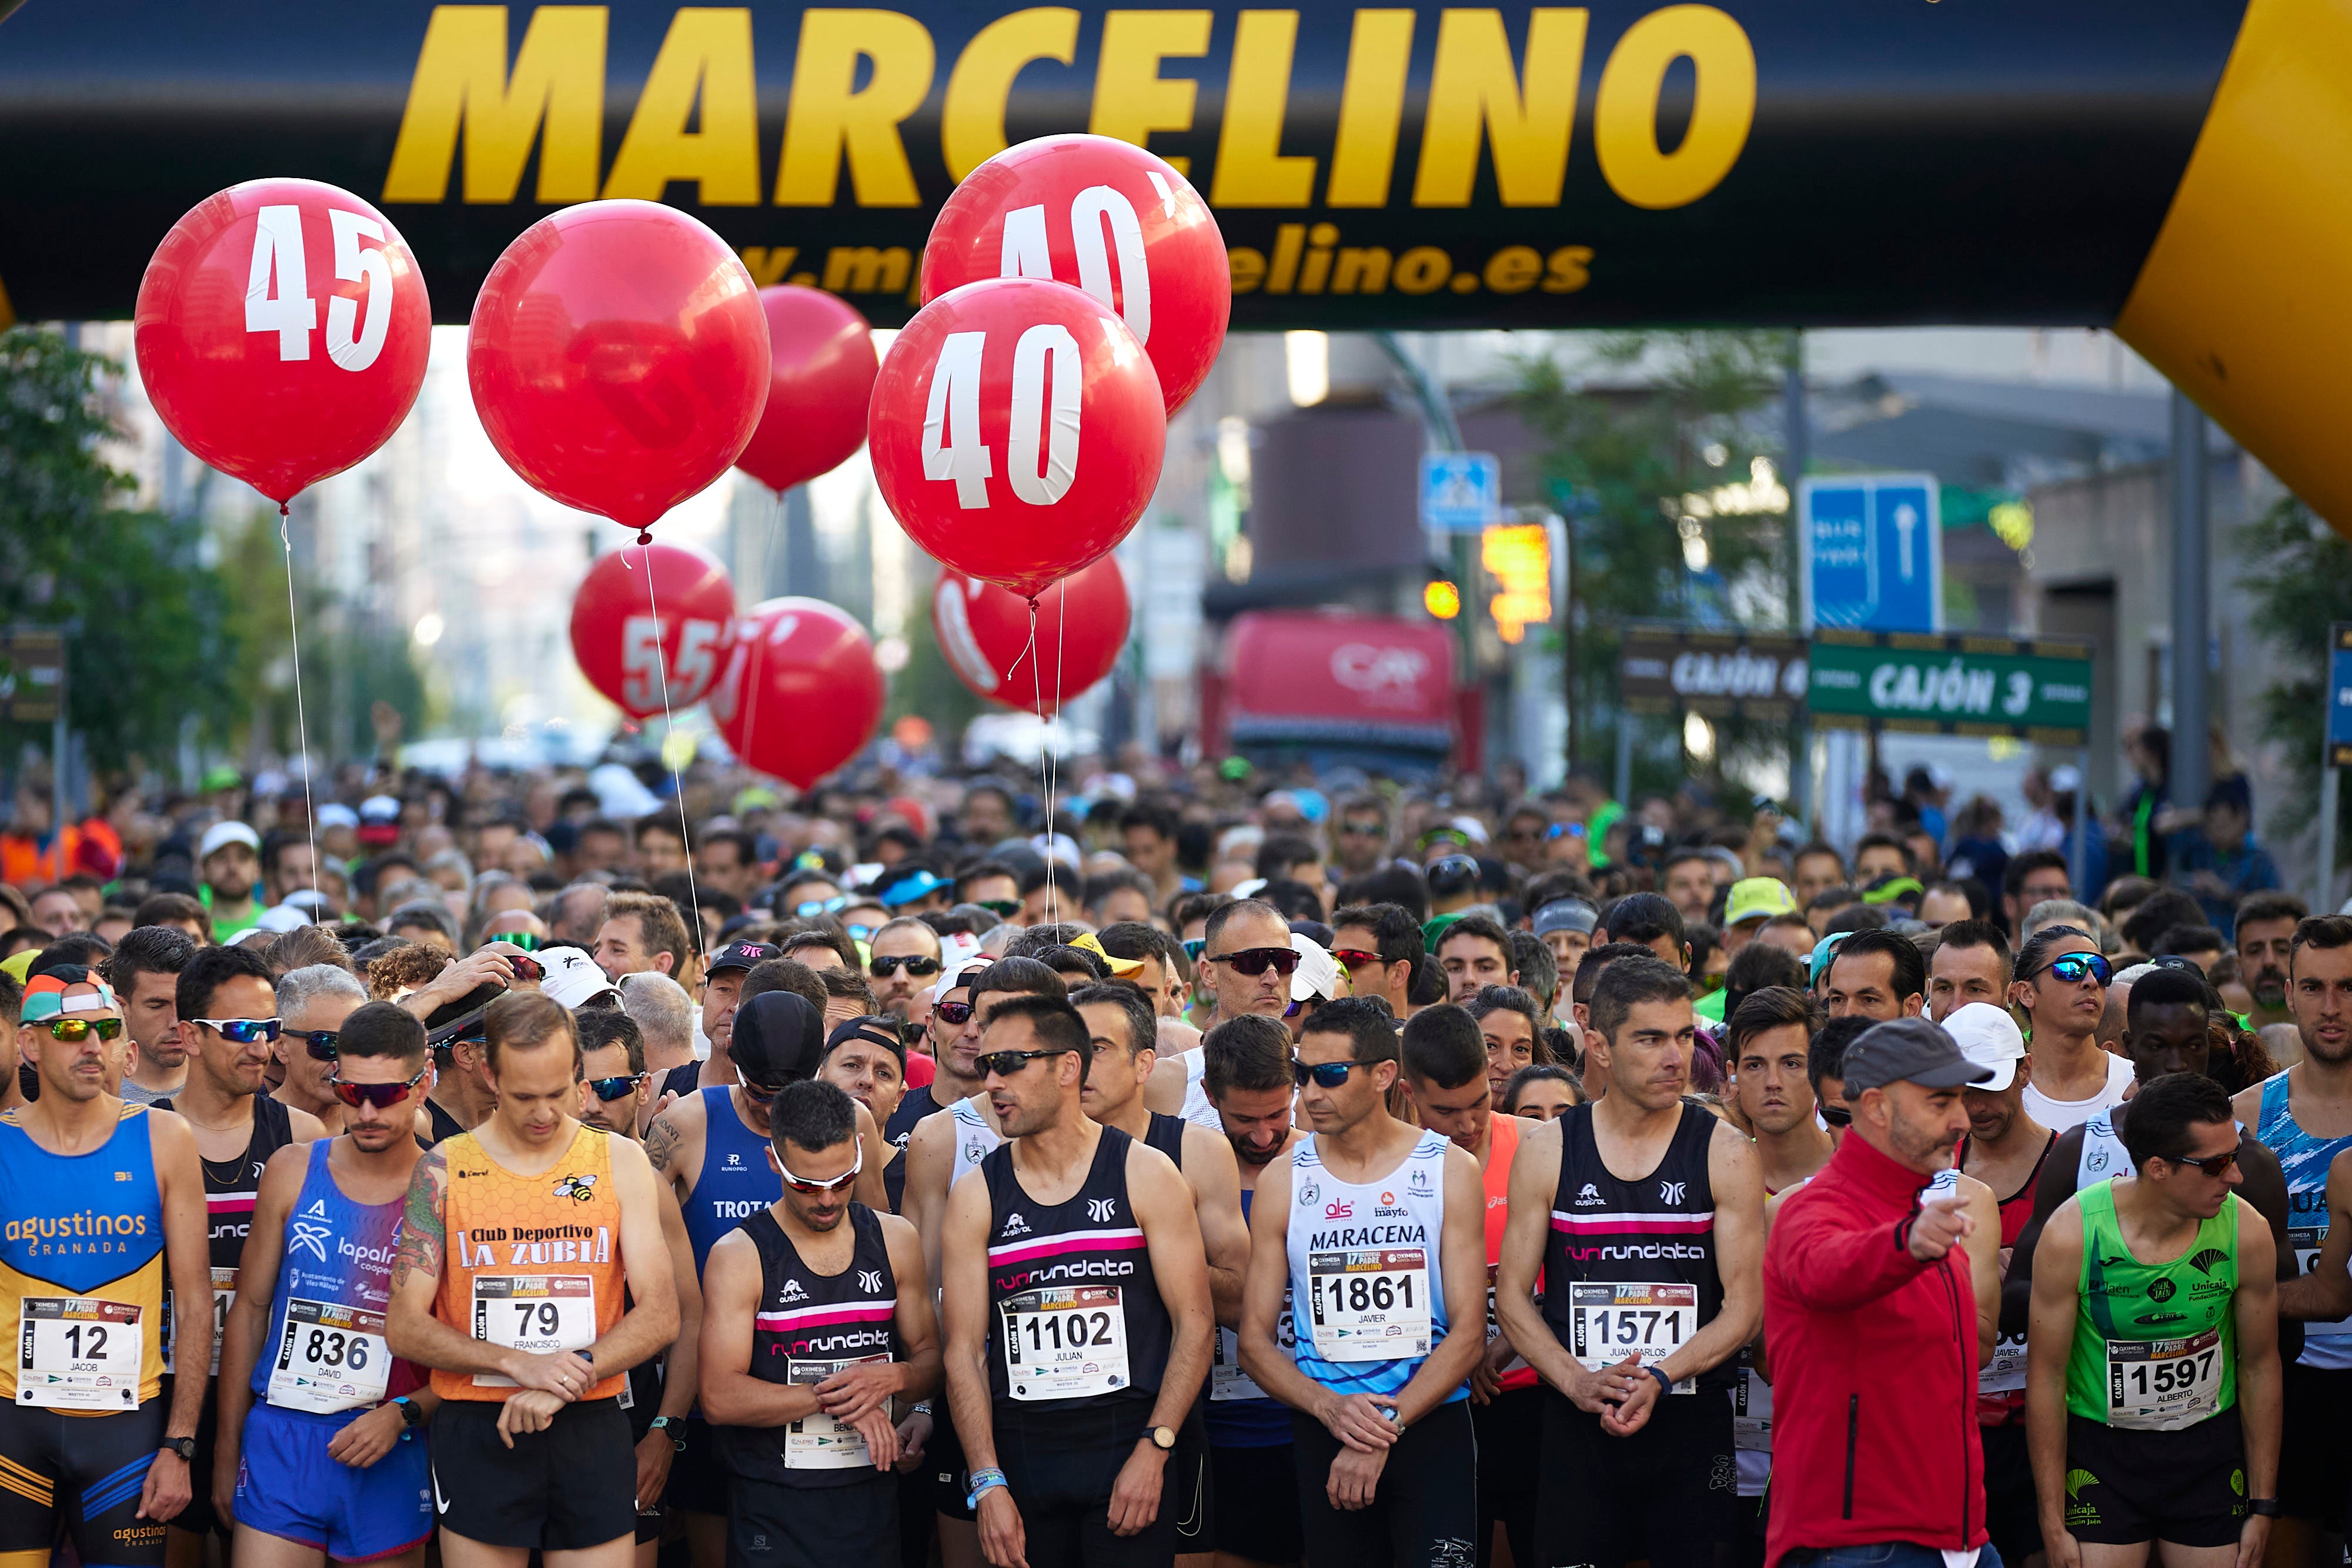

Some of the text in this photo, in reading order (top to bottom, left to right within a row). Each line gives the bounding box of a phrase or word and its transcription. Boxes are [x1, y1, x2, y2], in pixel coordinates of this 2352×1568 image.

[382, 3, 1757, 210] MARCELINO
[1870, 657, 1996, 715] CAJÓN
[2002, 671, 2034, 716] 3
[5, 1209, 146, 1246] agustinos
[472, 1225, 592, 1242] Club Deportivo
[2317, 1228, 2328, 1240] 17
[1310, 1225, 1426, 1251] MARACENA
[28, 1242, 126, 1256] GRANADA
[457, 1226, 609, 1267] LA ZUBIA
[1565, 1242, 1705, 1261] runrundata
[1346, 1253, 1359, 1265] 17
[1346, 1263, 1382, 1272] MARCELINO
[997, 1259, 1134, 1290] runrundata
[513, 1278, 525, 1290] 17
[2192, 1278, 2227, 1291] Unicaja
[512, 1289, 549, 1297] MARCELINO
[1041, 1291, 1053, 1303] 17
[1329, 1275, 1413, 1312] 1861
[1616, 1285, 1628, 1298] 17
[2189, 1292, 2218, 1302] Fundación
[64, 1300, 76, 1312] 17
[1041, 1300, 1077, 1310] MARCELINO
[1313, 1293, 1322, 1315] CAJÓN
[1614, 1296, 1652, 1305] MARCELINO
[76, 1305, 97, 1313] PADRE
[297, 1304, 317, 1312] OXIMESA
[321, 1305, 332, 1318] 17
[62, 1311, 99, 1320] MARCELINO
[331, 1311, 352, 1322] PADRE
[515, 1302, 559, 1336] 79
[1358, 1314, 1386, 1323] JAVIER
[319, 1316, 353, 1329] MARCELINO
[1594, 1310, 1679, 1344] 1571
[1026, 1312, 1112, 1350] 1102
[25, 1336, 33, 1359] CAJÓN
[65, 1325, 107, 1360] 12
[514, 1340, 560, 1349] FRANCISCO
[1010, 1331, 1019, 1355] CAJÓN
[2151, 1342, 2164, 1353] 17
[2164, 1344, 2185, 1353] PADRE
[283, 1340, 294, 1360] CAJÓN
[306, 1329, 369, 1370] 836
[1610, 1348, 1631, 1356] JUAN
[1995, 1348, 2019, 1357] JAVIER
[2150, 1349, 2187, 1359] MARCELINO
[1055, 1352, 1083, 1362] JULIAN
[70, 1363, 98, 1372] JACOB
[318, 1368, 342, 1379] DAVID
[2132, 1349, 2216, 1395] 1597
[2157, 1389, 2193, 1403] ALBERTO
[2066, 1503, 2096, 1516] Unicaja
[113, 1524, 166, 1542] agustinos
